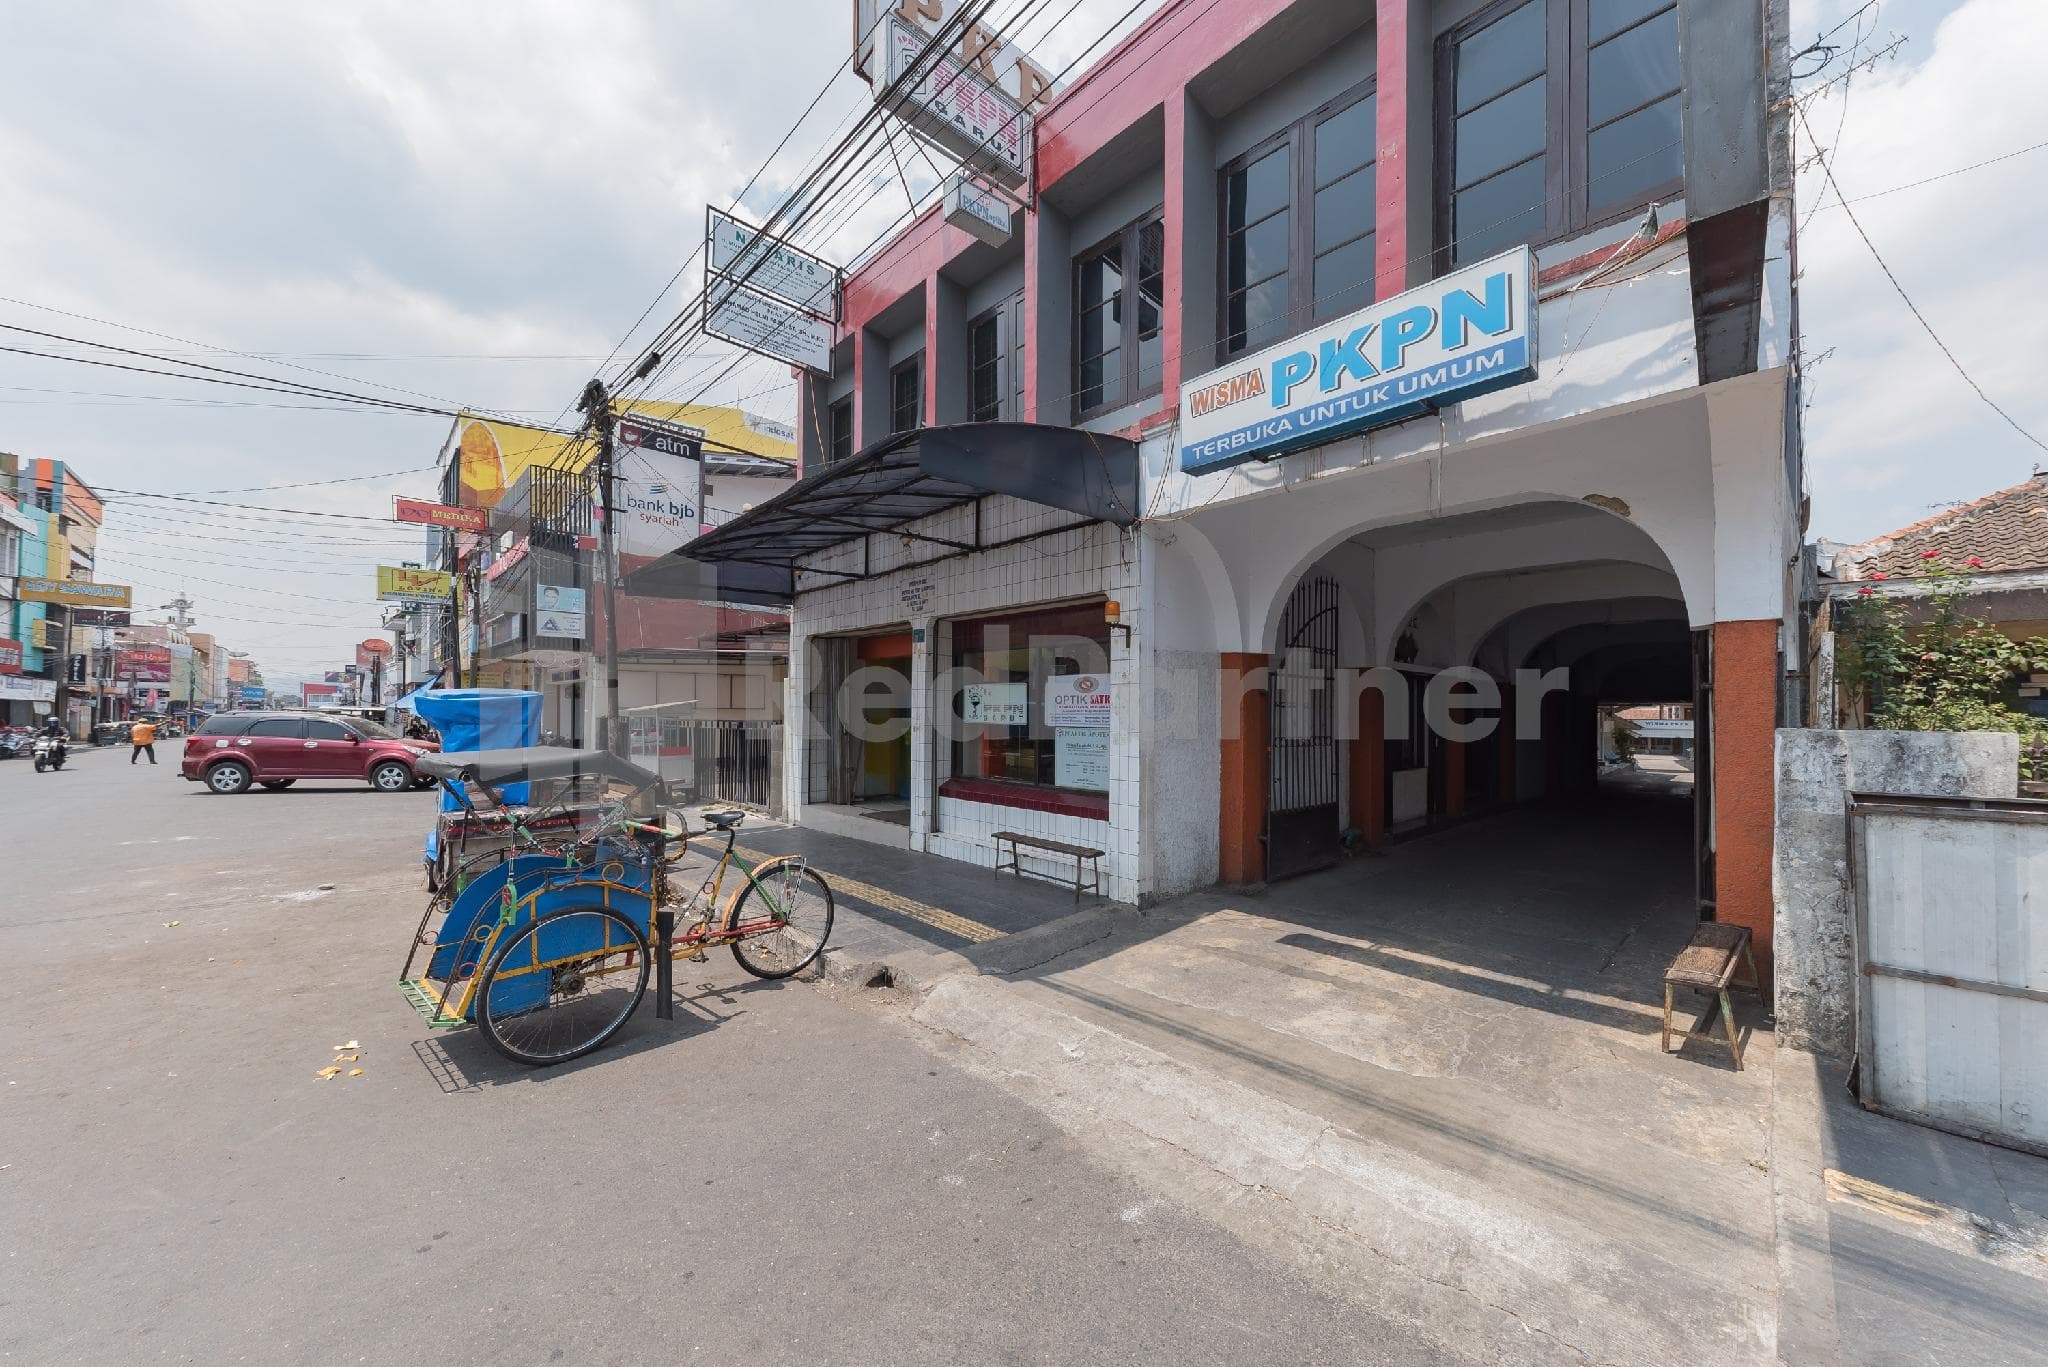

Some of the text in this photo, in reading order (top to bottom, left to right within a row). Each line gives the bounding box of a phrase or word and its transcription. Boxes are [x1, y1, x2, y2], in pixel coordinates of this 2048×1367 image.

[934, 100, 1018, 160] GARUT
[735, 230, 815, 276] NTARIS
[1190, 271, 1514, 418] WISMA PKPN
[1192, 348, 1505, 460] TERBUKA UNTUK UMUM
[655, 436, 690, 456] atm
[627, 494, 695, 520] bank bjb
[639, 512, 680, 527] syariah
[1055, 695, 1088, 704] OPTIK
